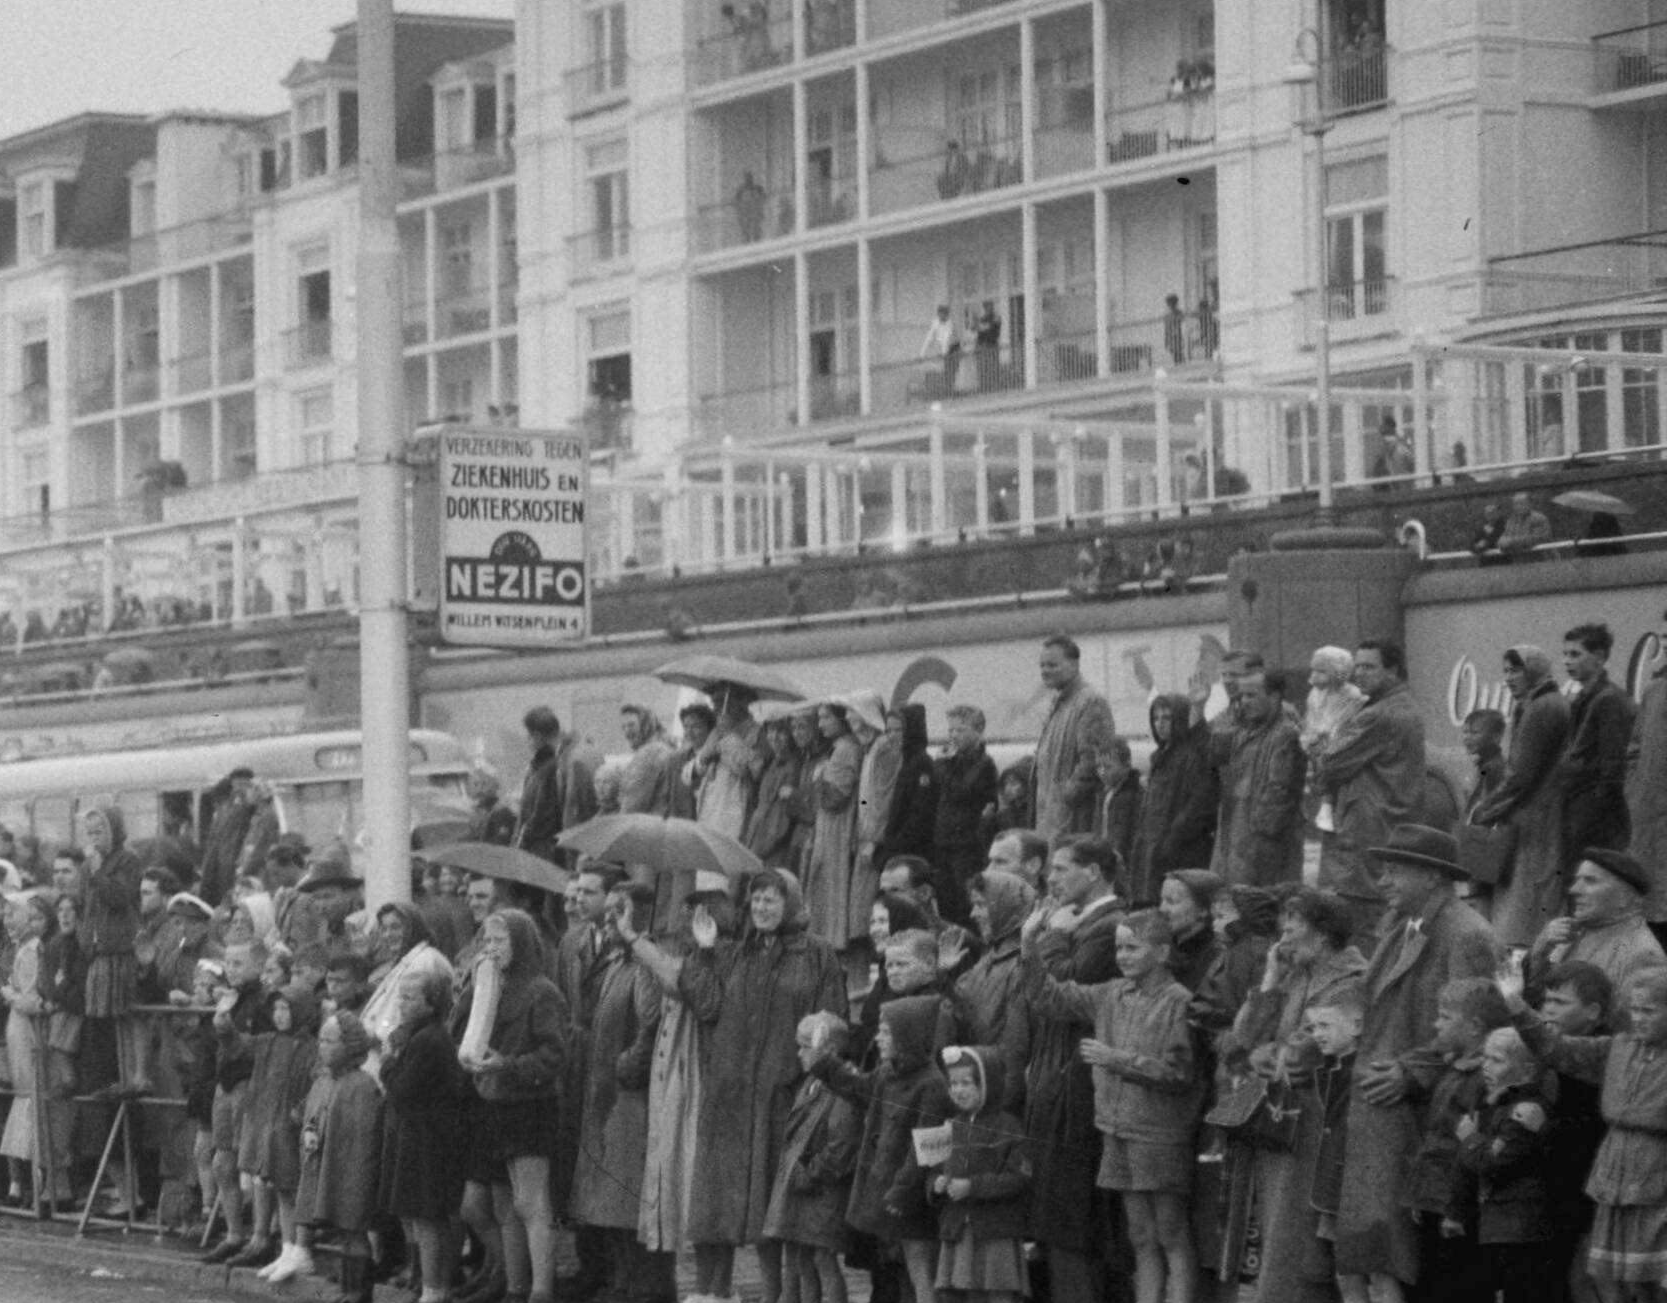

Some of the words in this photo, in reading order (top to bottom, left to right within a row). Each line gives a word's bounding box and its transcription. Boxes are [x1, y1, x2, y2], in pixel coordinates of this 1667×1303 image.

[446, 438, 534, 458] VERZEKERING
[543, 440, 583, 460] TEGEN
[450, 463, 551, 492] ZIEKENHUIS
[557, 474, 579, 492] EN
[446, 496, 585, 525] DOKTERSKOSTEN
[449, 562, 583, 602] NEZIFO
[447, 614, 492, 631] WILLEM
[570, 617, 579, 631] 4
